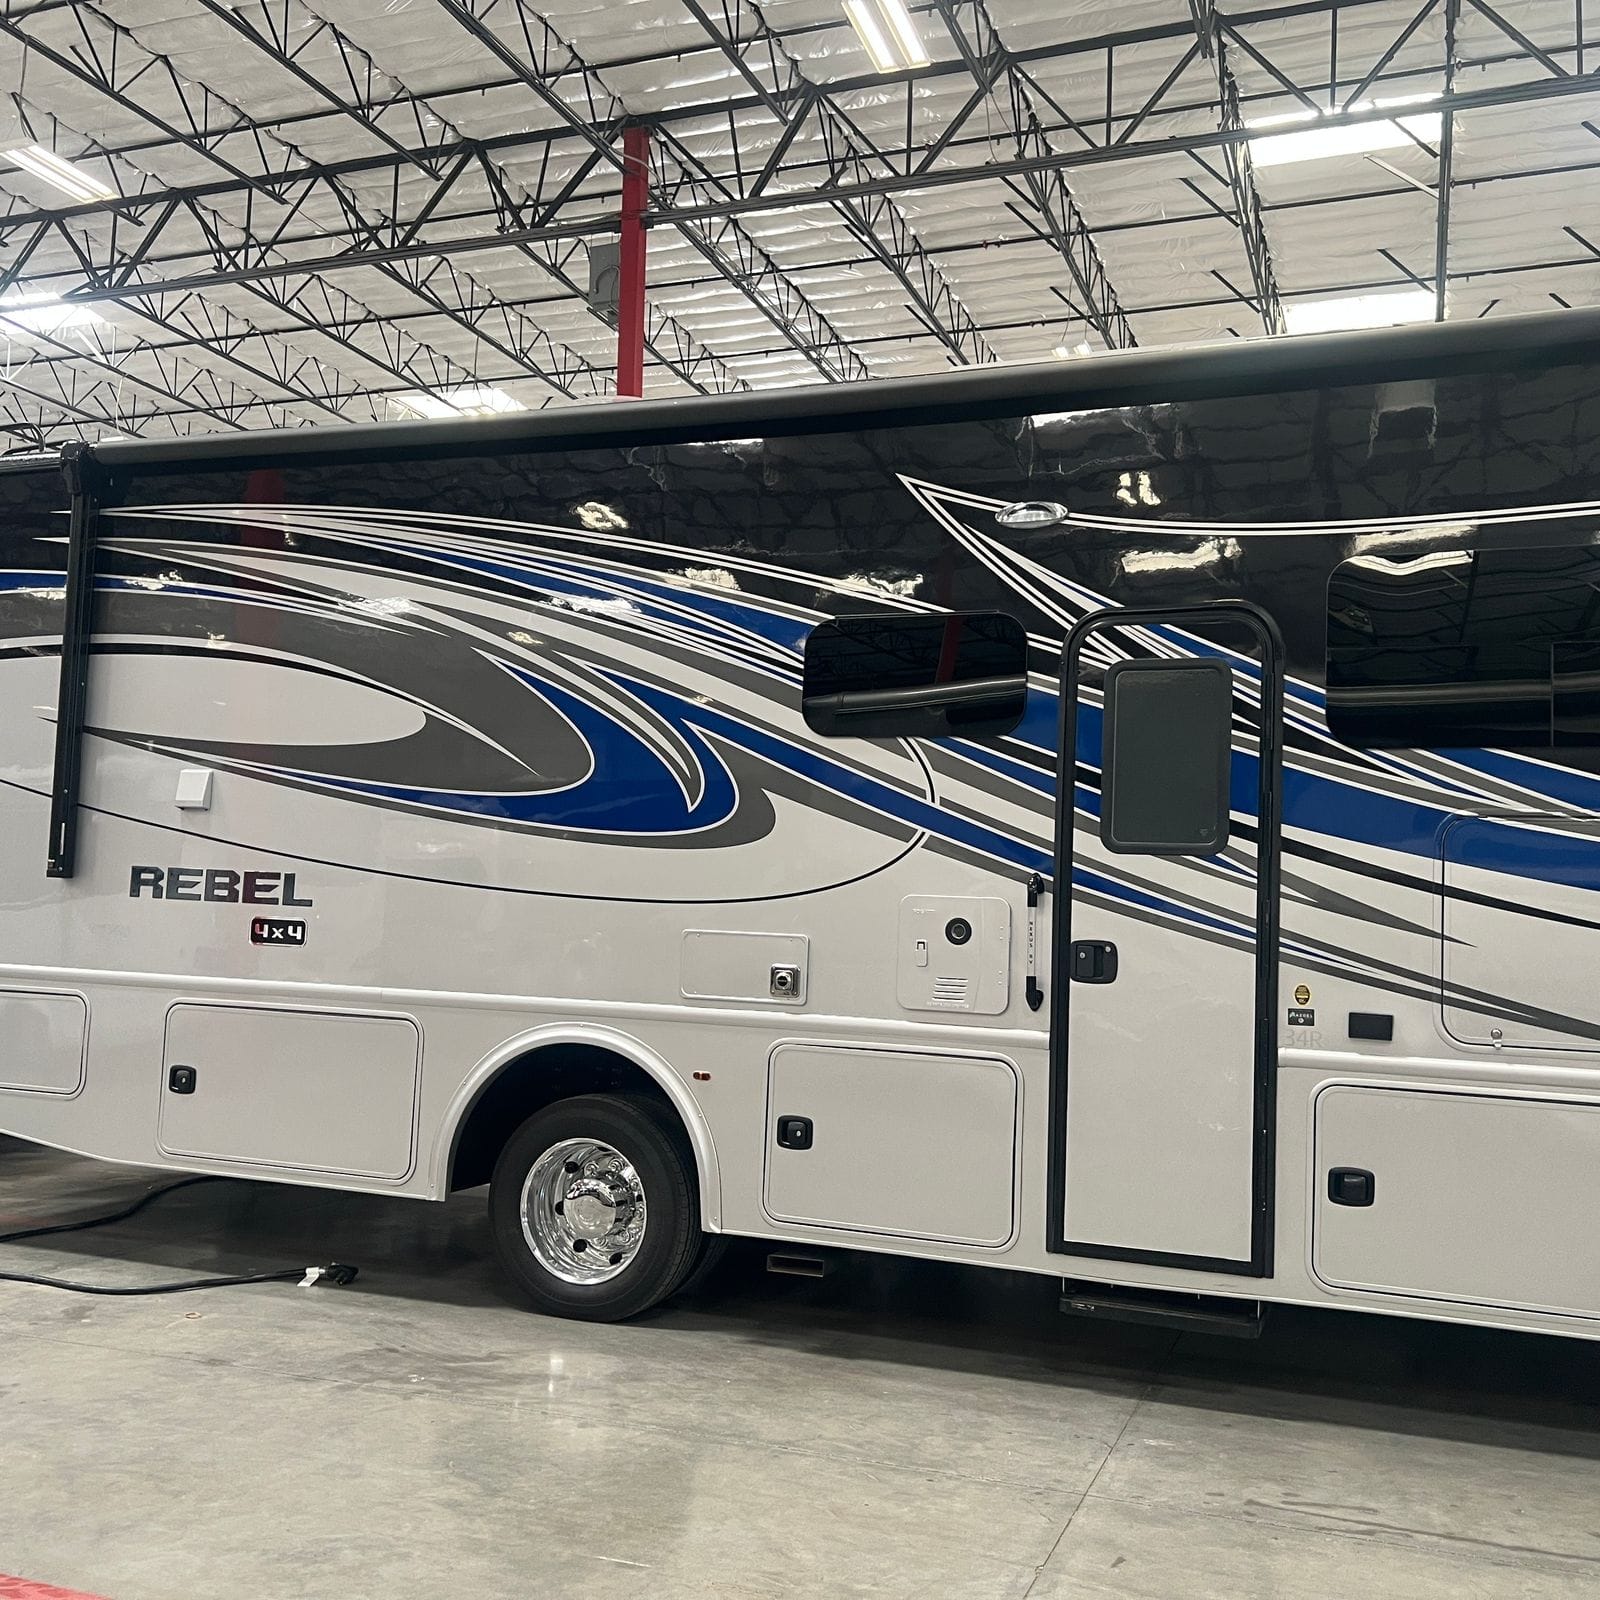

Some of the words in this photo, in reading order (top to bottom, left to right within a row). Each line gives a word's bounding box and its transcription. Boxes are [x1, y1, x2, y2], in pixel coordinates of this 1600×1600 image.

[129, 866, 313, 907] REBEL
[254, 923, 302, 940] 4x4
[1281, 1029, 1324, 1048] 34R
